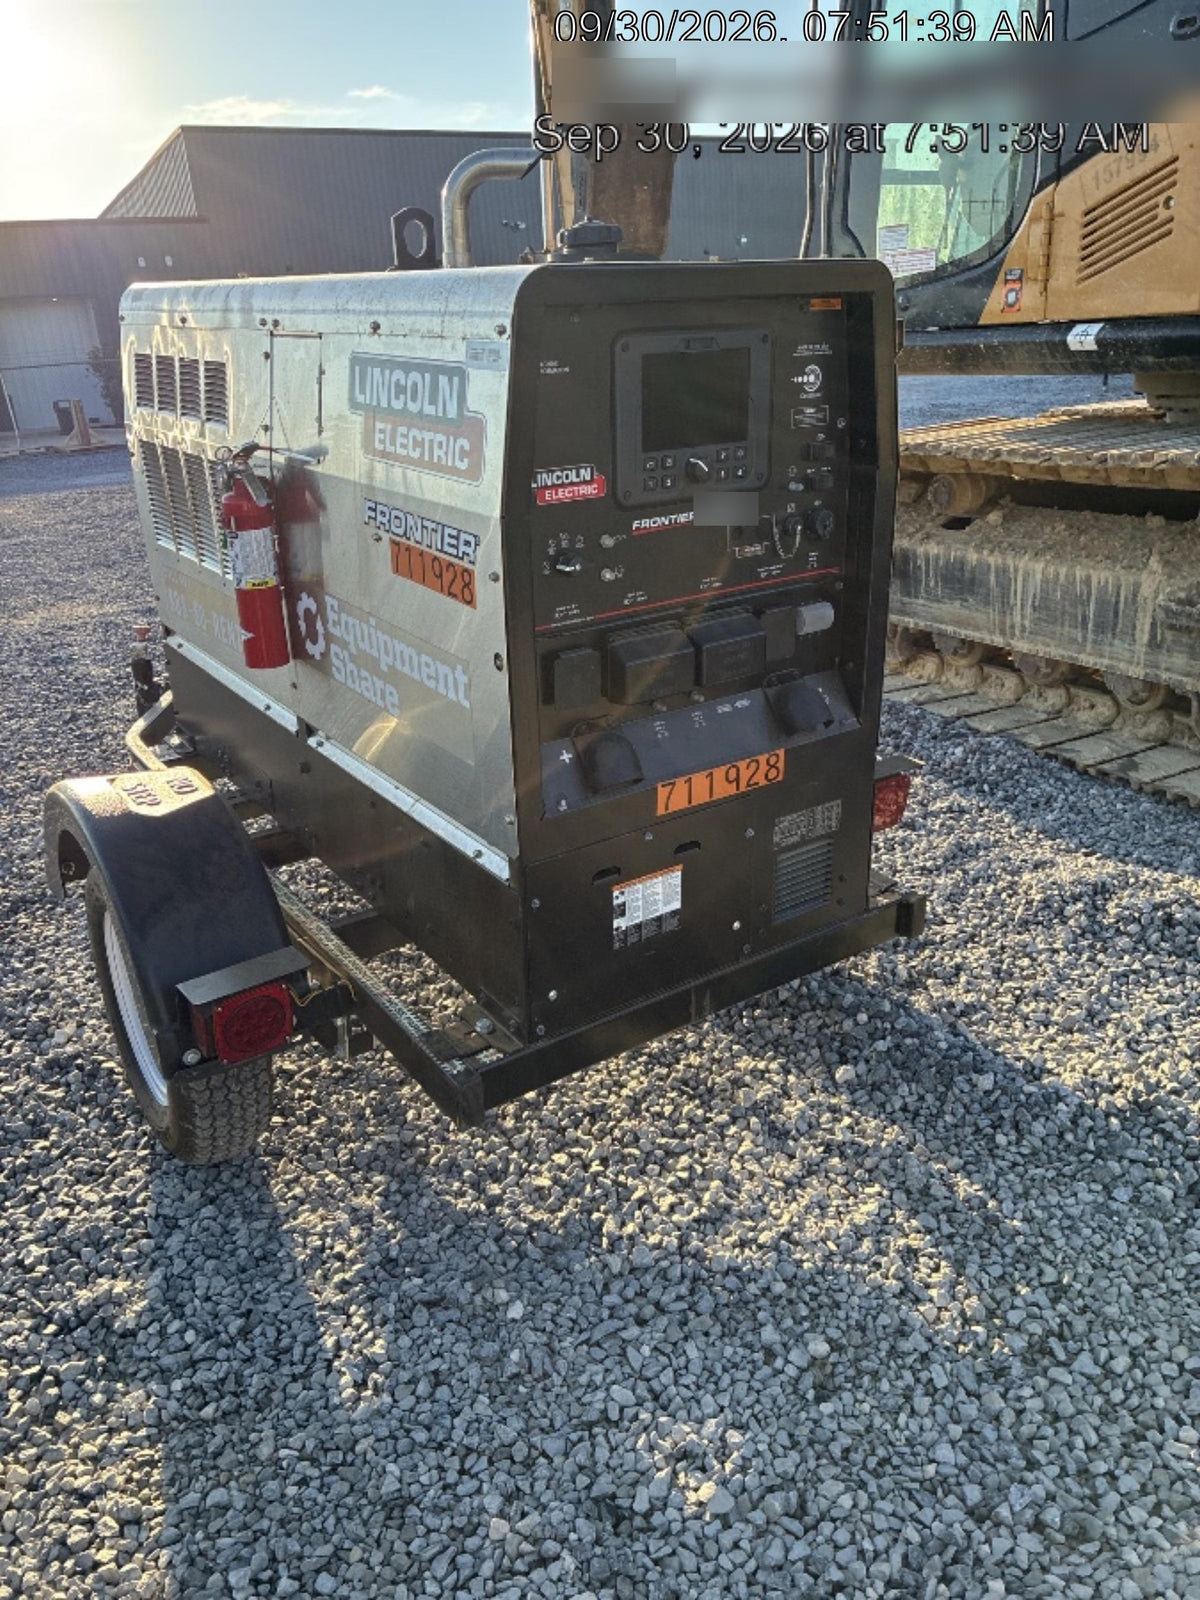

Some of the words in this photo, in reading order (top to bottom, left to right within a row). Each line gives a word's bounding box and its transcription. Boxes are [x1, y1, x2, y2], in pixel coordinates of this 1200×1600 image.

[354, 365, 459, 419] LINCOLN
[374, 420, 470, 470] ELECTRIC
[531, 467, 591, 488] LINCOLN
[545, 484, 598, 500] ELECTRIC
[363, 498, 478, 565] FRONTIER
[391, 541, 474, 606] 711928
[324, 594, 470, 709] Equipment
[329, 642, 399, 717] Share
[660, 752, 780, 812] 711928
